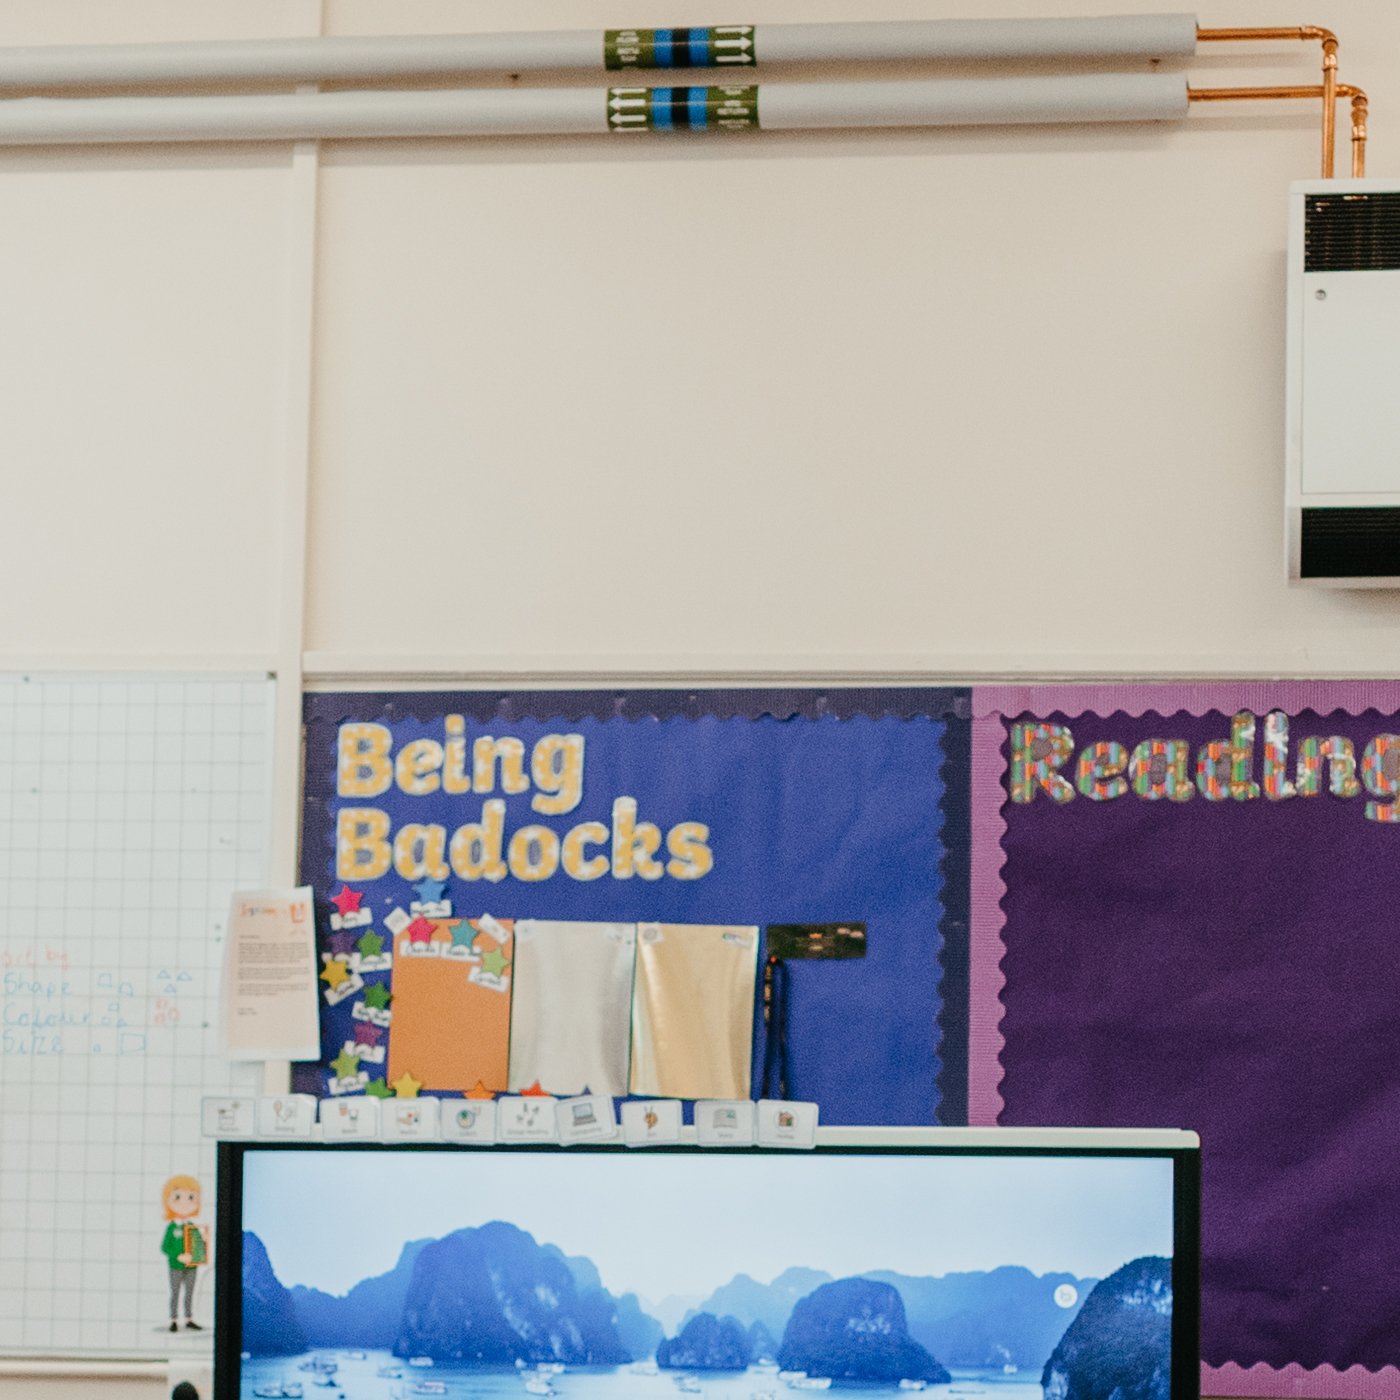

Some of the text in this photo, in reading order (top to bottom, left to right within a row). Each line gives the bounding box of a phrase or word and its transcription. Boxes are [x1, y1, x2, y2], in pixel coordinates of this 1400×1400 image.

[337, 714, 585, 815] Being
[337, 798, 714, 881] Badocks
[3, 970, 73, 1002] Shape
[3, 1002, 92, 1028] Colour
[2, 1028, 65, 1056] Size
